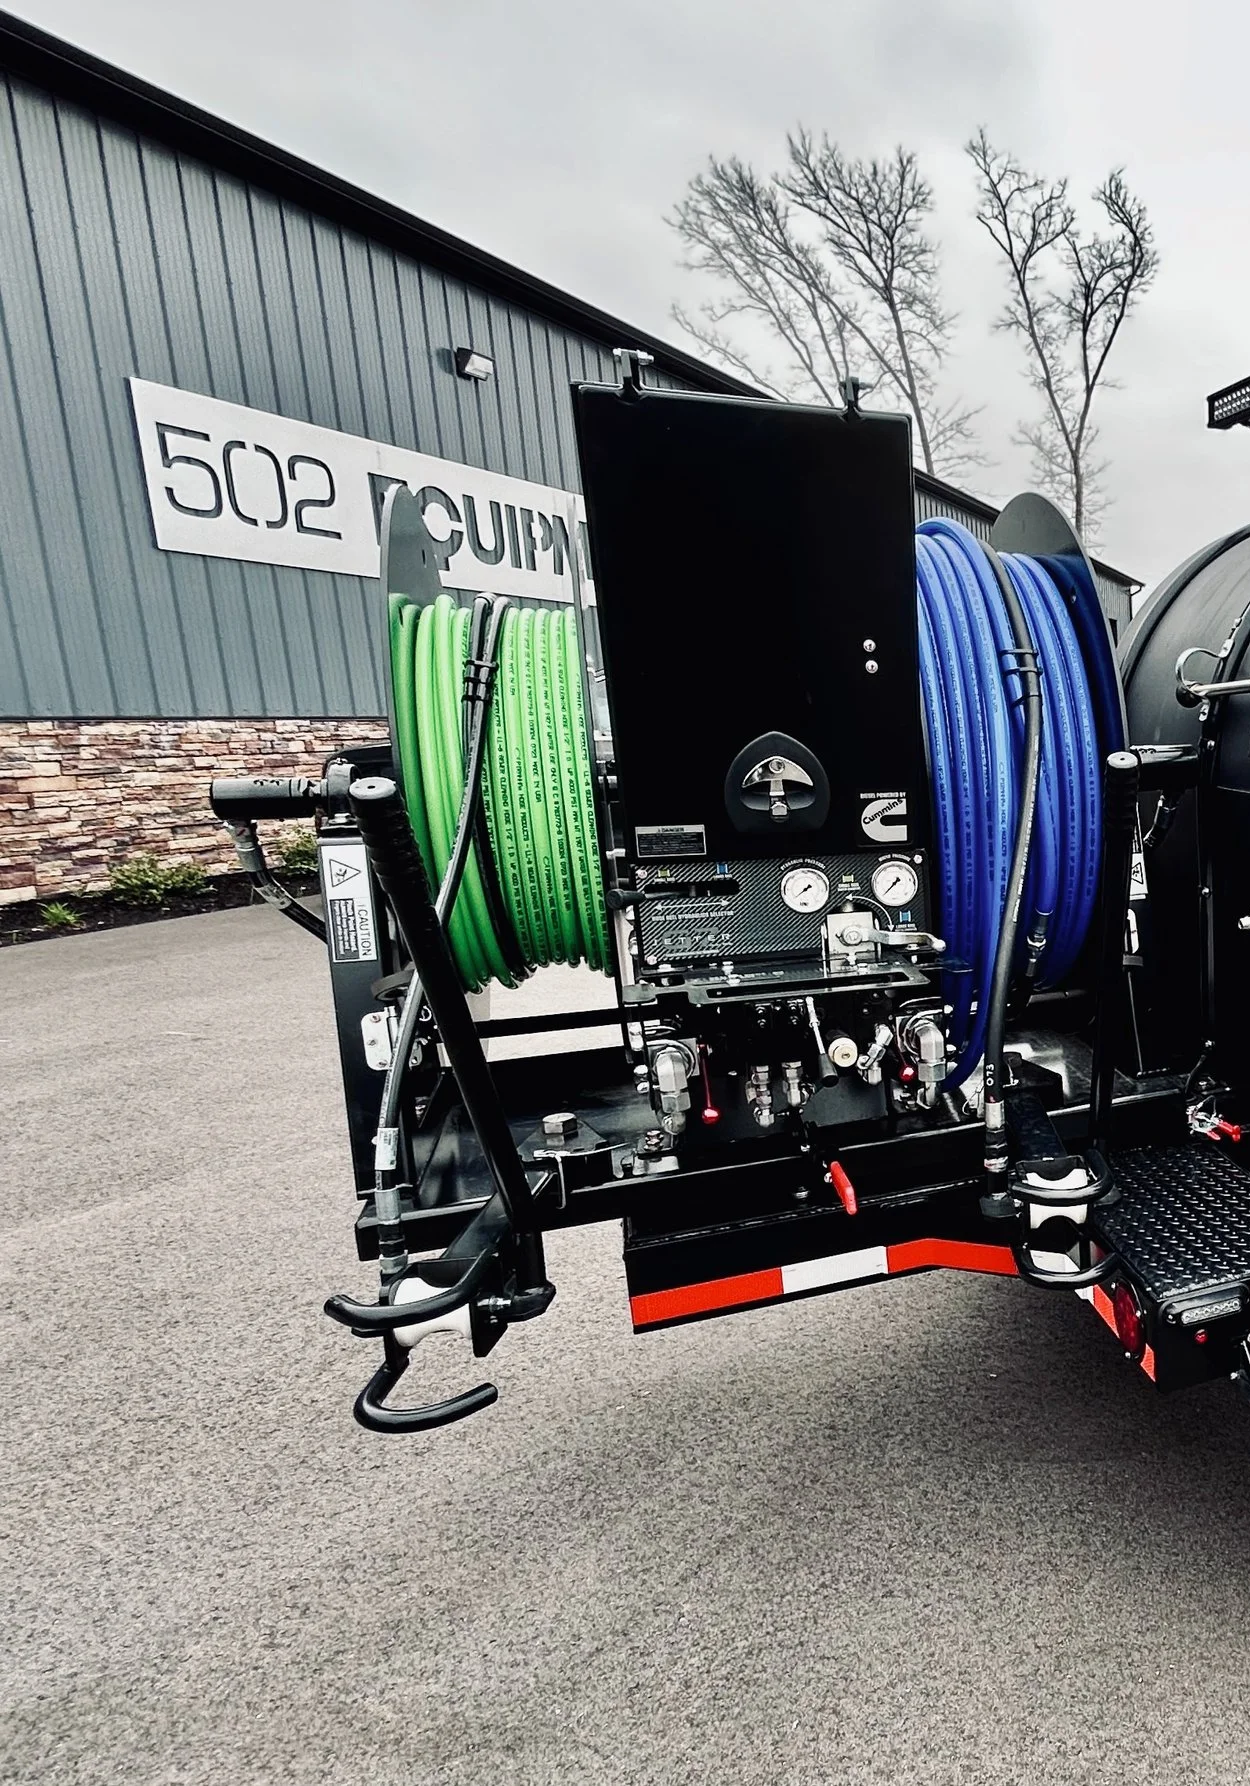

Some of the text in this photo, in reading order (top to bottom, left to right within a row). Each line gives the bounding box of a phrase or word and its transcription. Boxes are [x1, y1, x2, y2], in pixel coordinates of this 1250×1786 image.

[156, 422, 342, 541] 502
[862, 799, 904, 824] Cummins
[358, 909, 372, 956] CAUTION
